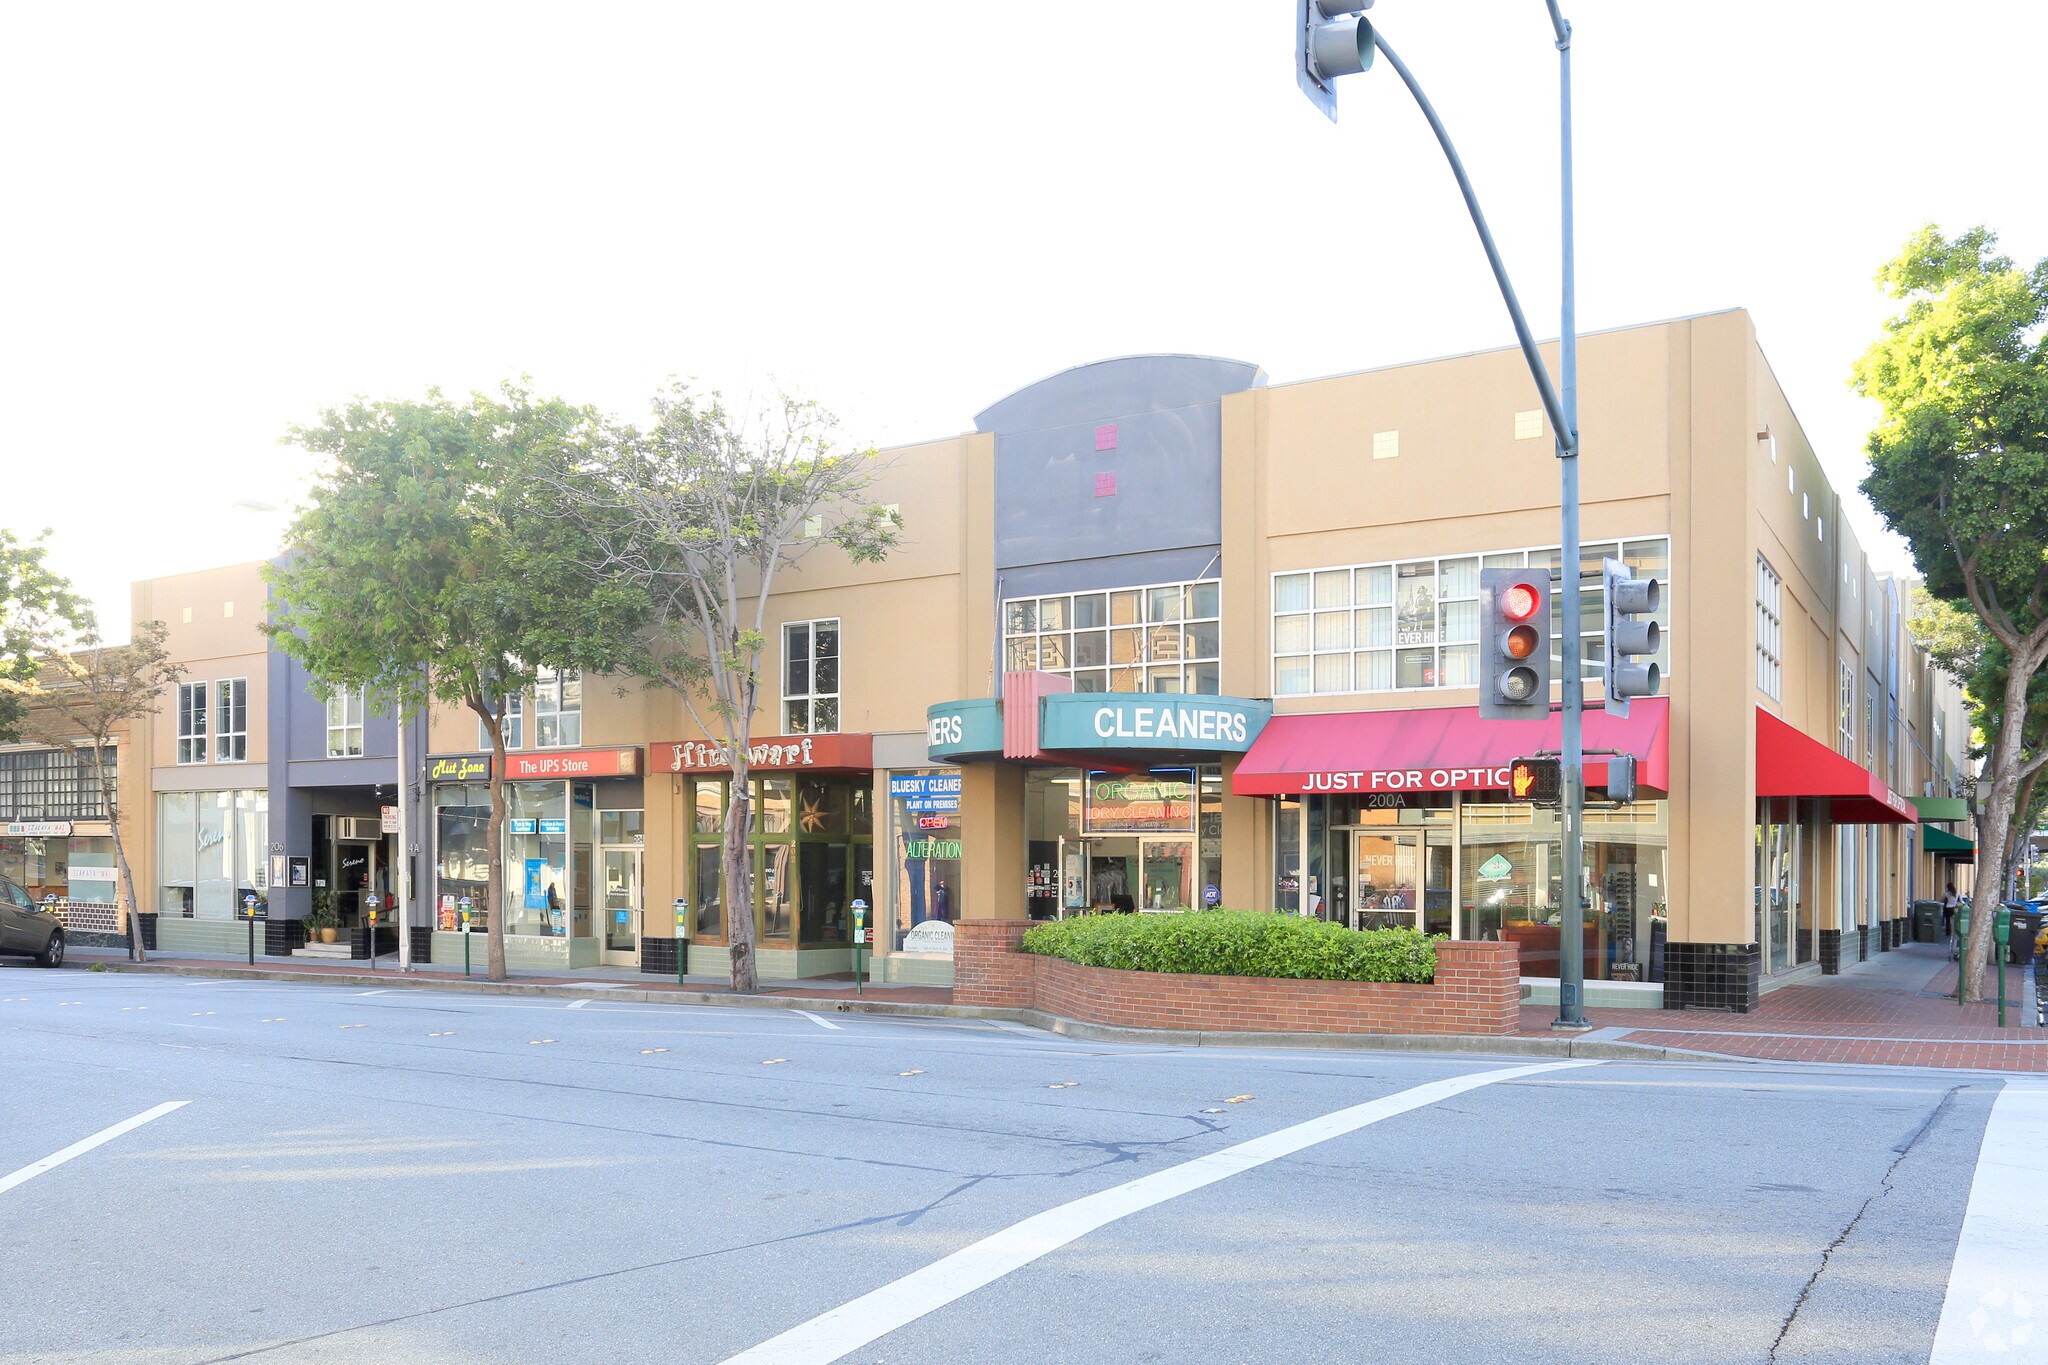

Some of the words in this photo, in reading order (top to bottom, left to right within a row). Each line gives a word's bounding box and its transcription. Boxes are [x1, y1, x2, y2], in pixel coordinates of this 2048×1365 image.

[1398, 632, 1422, 644] EVER
[1424, 630, 1445, 643] HIE
[1094, 707, 1247, 743] CLEANERS
[458, 758, 485, 780] Zone
[519, 761, 537, 773] The
[540, 759, 559, 772] UPS
[562, 758, 588, 771] Store
[891, 779, 926, 793] BLUESKY
[1302, 772, 1363, 790] JUST
[1371, 771, 1423, 789] FOR
[1095, 781, 1187, 801] ORGANIC
[906, 800, 922, 809] PLANT
[924, 800, 932, 809] ON
[933, 800, 957, 809] PREMISES
[1368, 794, 1406, 807] 200A
[1091, 806, 1119, 819] DRY
[1122, 805, 1190, 818] CLEANING
[920, 817, 947, 827] OPEN
[270, 842, 284, 851] 206
[342, 858, 365, 869] Sereno
[1365, 854, 1393, 866] NEVER
[910, 930, 934, 941] ORGANIC
[1611, 962, 1627, 971] NEVER
